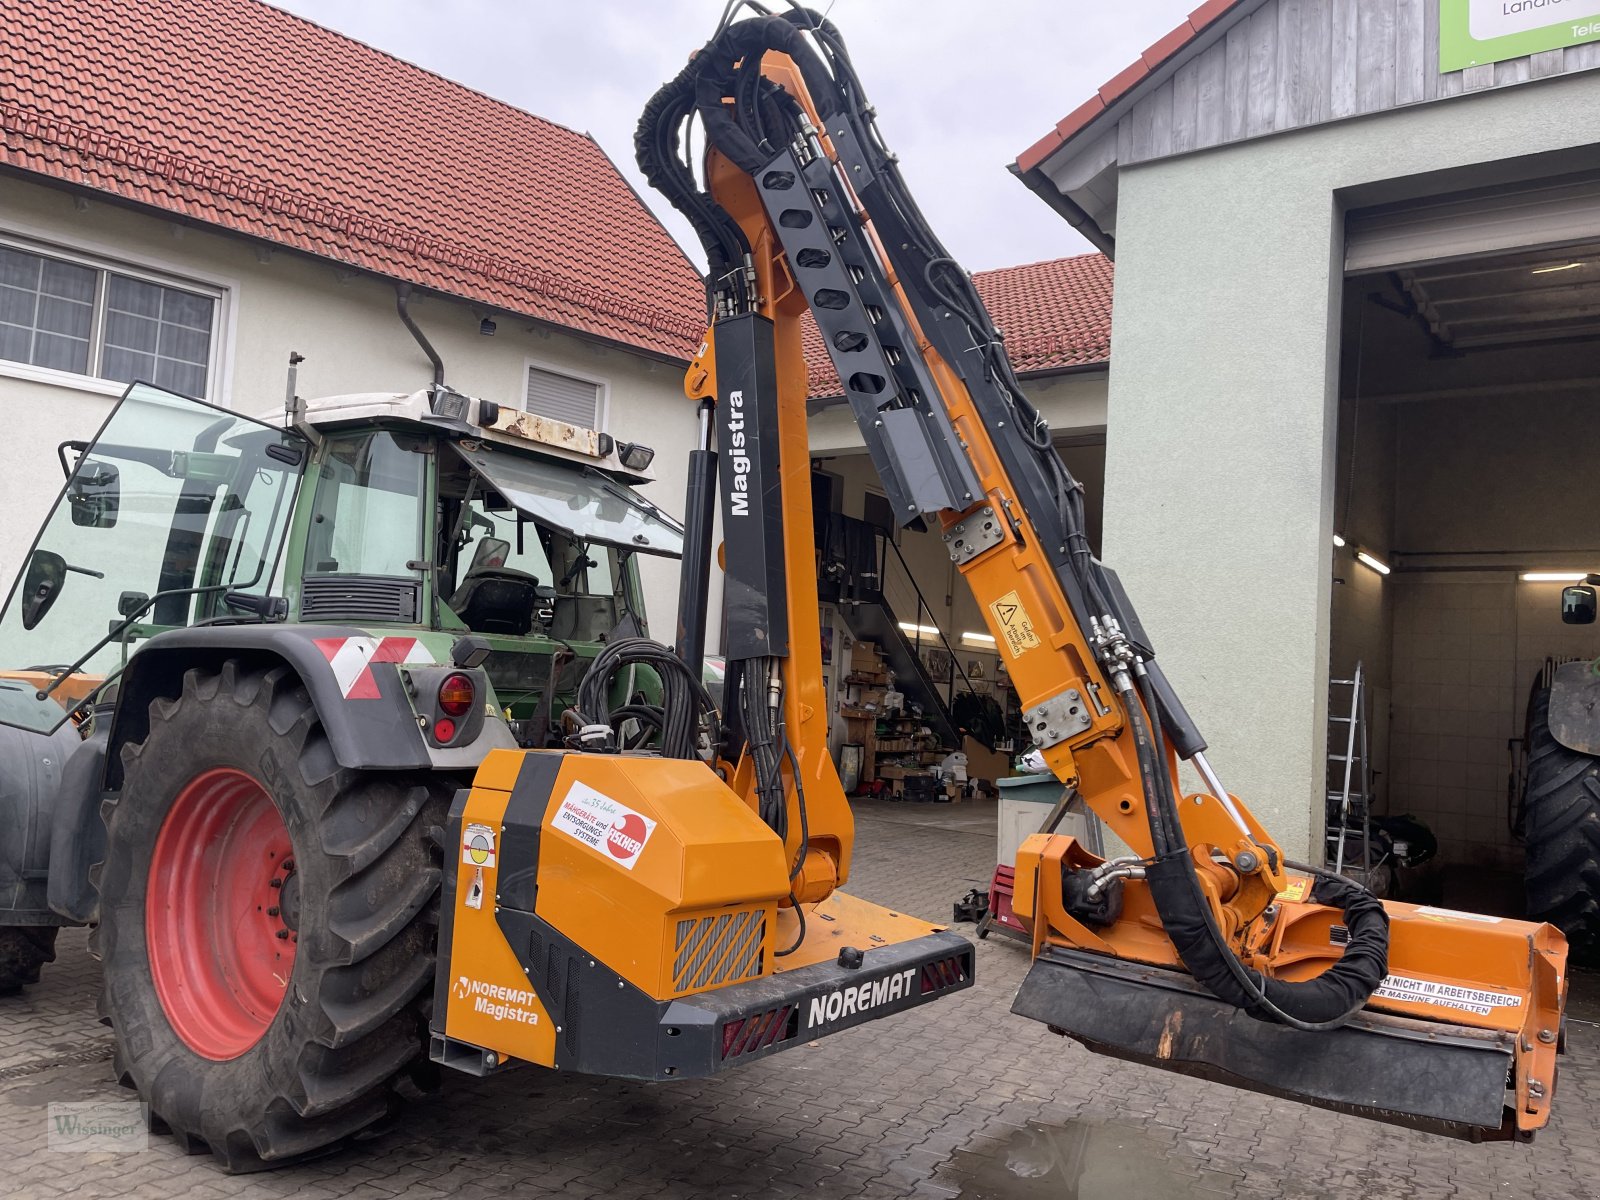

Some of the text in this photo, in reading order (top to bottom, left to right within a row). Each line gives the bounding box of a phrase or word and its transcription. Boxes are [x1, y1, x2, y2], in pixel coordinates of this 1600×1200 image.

[728, 390, 750, 516] Magistra
[1020, 632, 1027, 640] im
[1021, 621, 1034, 642] Gefahr
[591, 798, 601, 808] 35
[562, 811, 603, 837] ENTSORGUNGS-
[596, 819, 609, 830] und
[573, 828, 600, 847] SYSTEME
[609, 826, 641, 855] FISCHER
[471, 980, 536, 1006] NOREMAT
[808, 968, 916, 1028] NOREMAT
[1388, 990, 1431, 1003] MASHINE
[1433, 999, 1489, 1014] AUFHALTEN
[1393, 978, 1422, 991] NICHT
[1424, 983, 1435, 993] IM
[1437, 985, 1520, 1007] ARBEITSBEREICH
[475, 996, 539, 1025] Magistra
